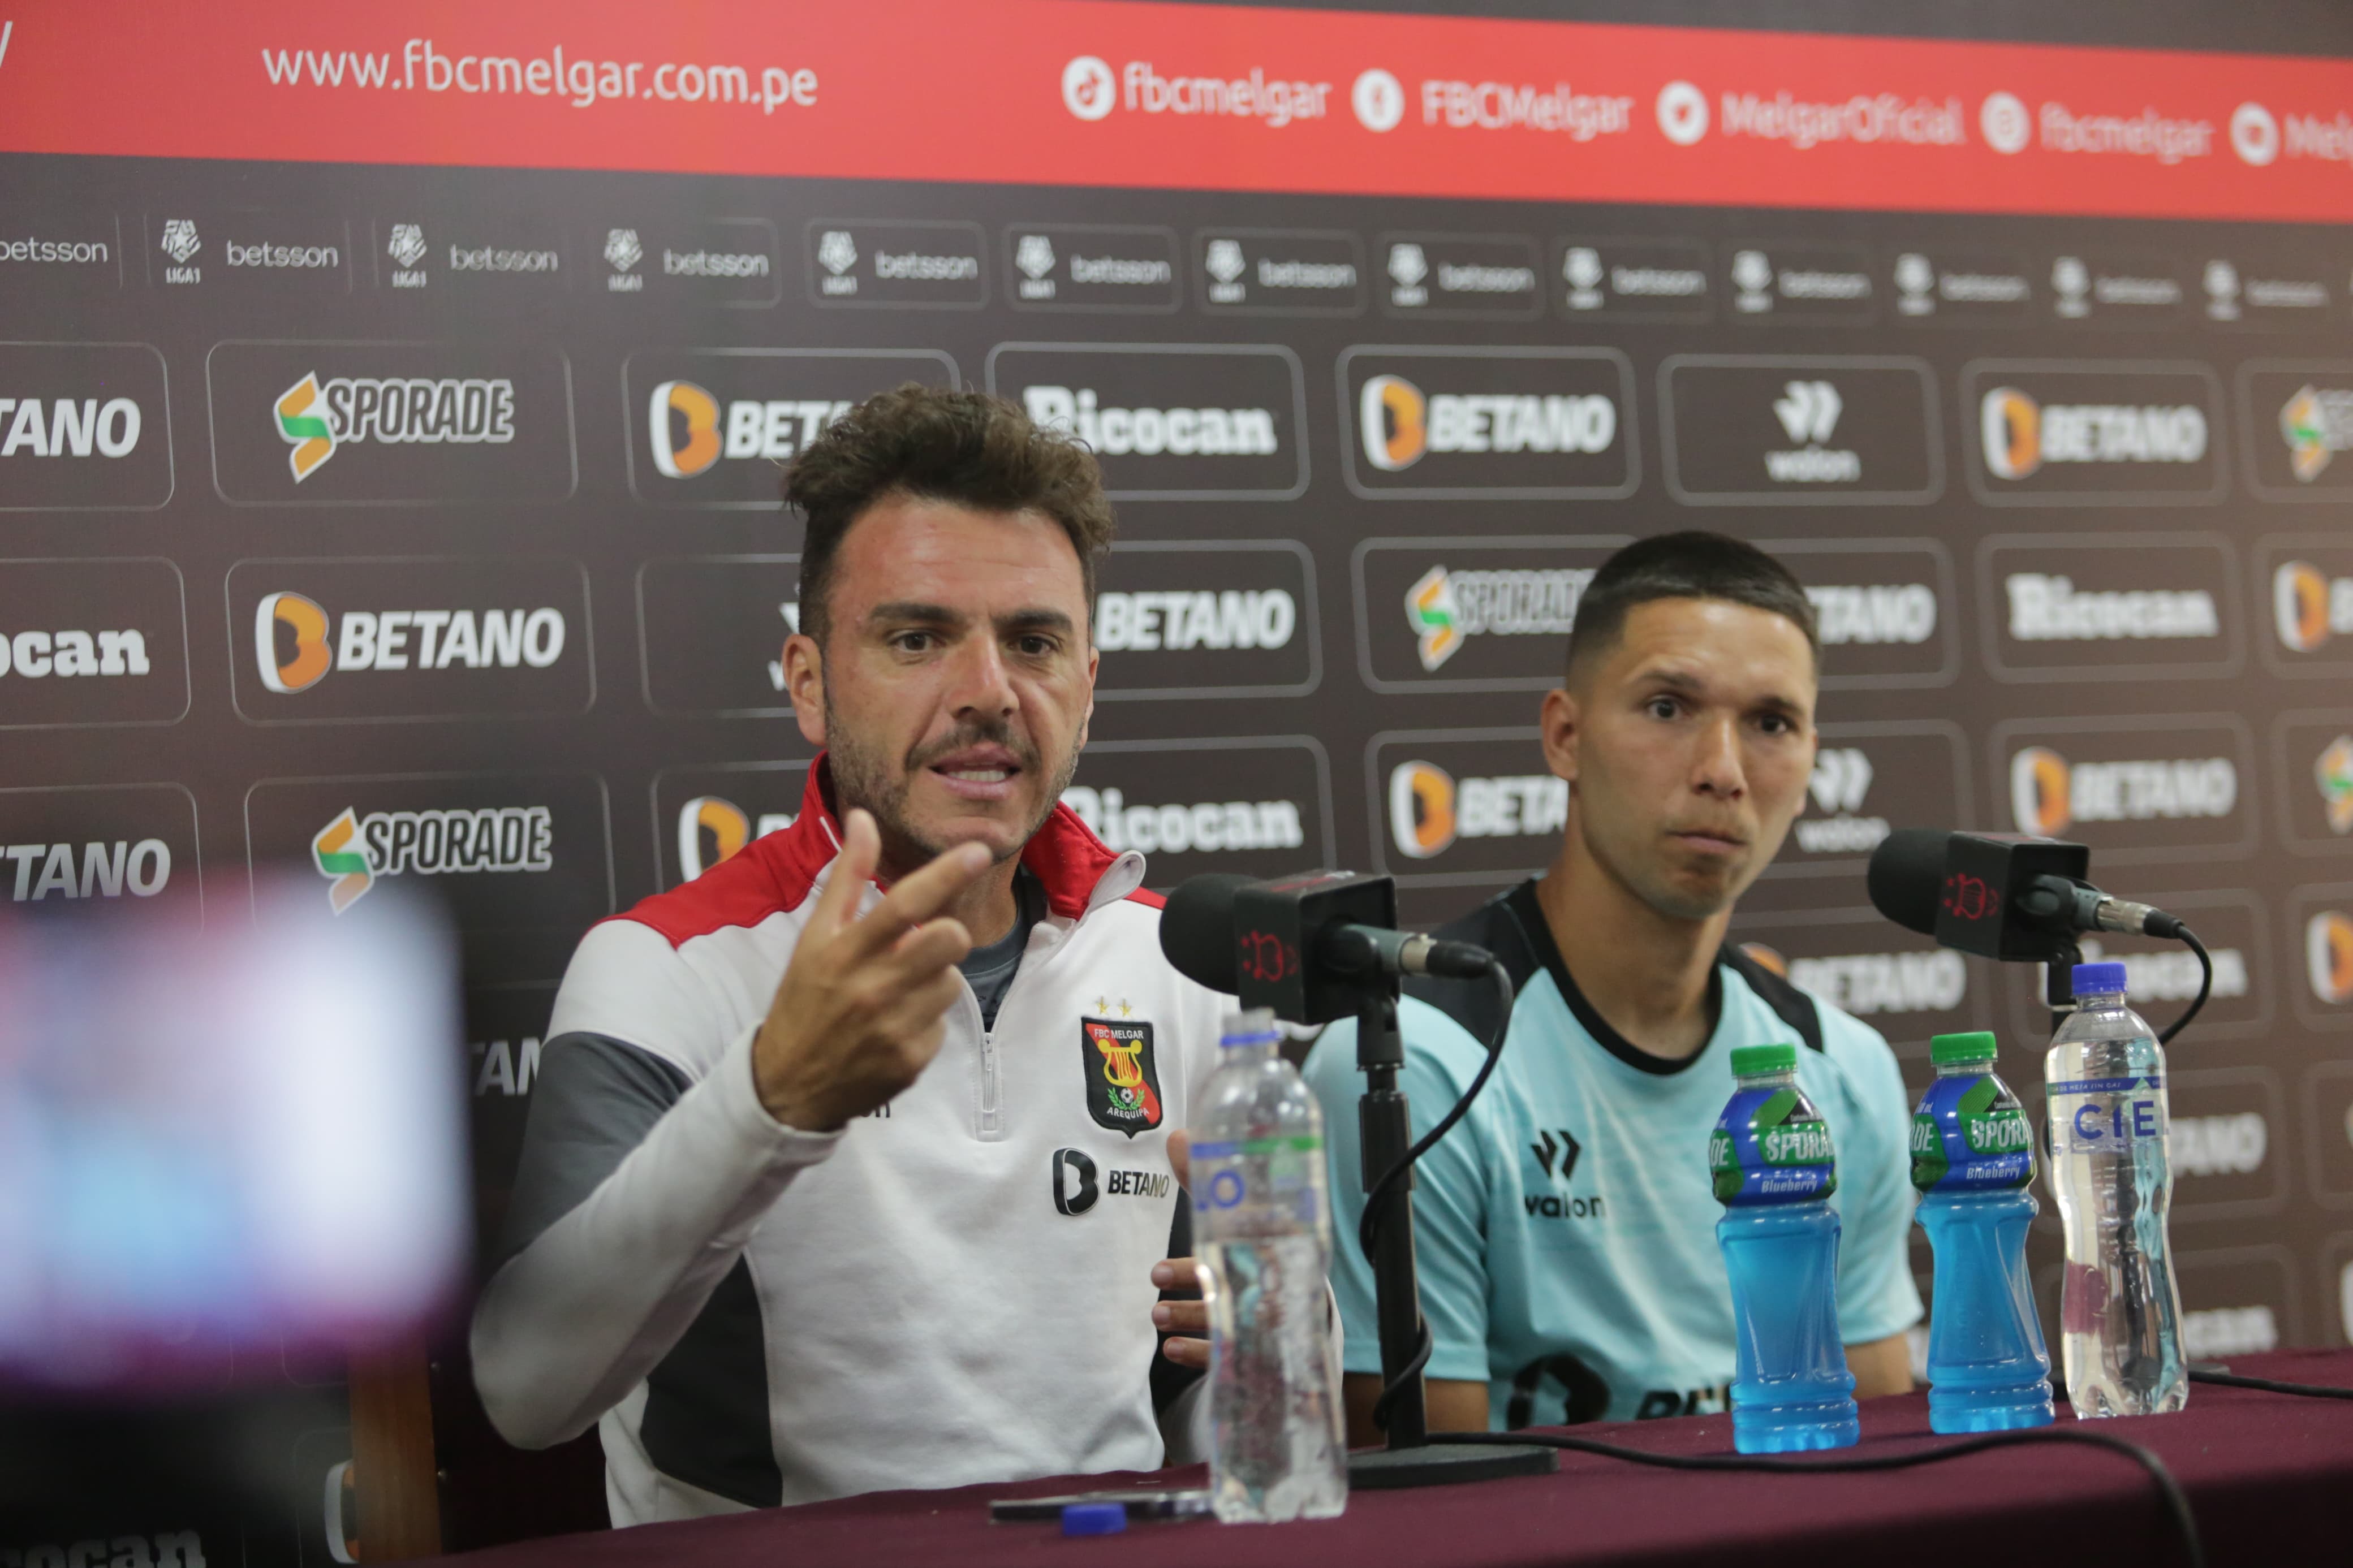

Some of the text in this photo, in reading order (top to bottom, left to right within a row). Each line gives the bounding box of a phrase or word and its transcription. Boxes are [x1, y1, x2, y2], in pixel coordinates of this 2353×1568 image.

[261, 38, 818, 115] www.fbcmelgar.com.pe
[1123, 61, 1333, 128] fbcmelgar
[1421, 79, 1635, 141] FBCMelgar
[227, 240, 338, 267] betsson
[450, 244, 558, 271] betsson
[663, 249, 769, 277] betsson
[875, 250, 978, 280] betsson
[326, 378, 515, 443] SPORADE
[724, 400, 857, 459] BET
[1427, 394, 1617, 453] BETANO
[2041, 404, 2208, 463] BETANO
[337, 607, 565, 671] BETANO
[1093, 588, 1296, 651] BETANO
[362, 806, 553, 875] SPORADE
[1094, 1028, 1144, 1039] FBC MELGAR
[1106, 1107, 1150, 1119] AREQUIPA
[1107, 1170, 1170, 1198] BETANO
[1761, 1178, 1818, 1194] Blueberry
[1966, 1165, 2021, 1180] Blueberry
